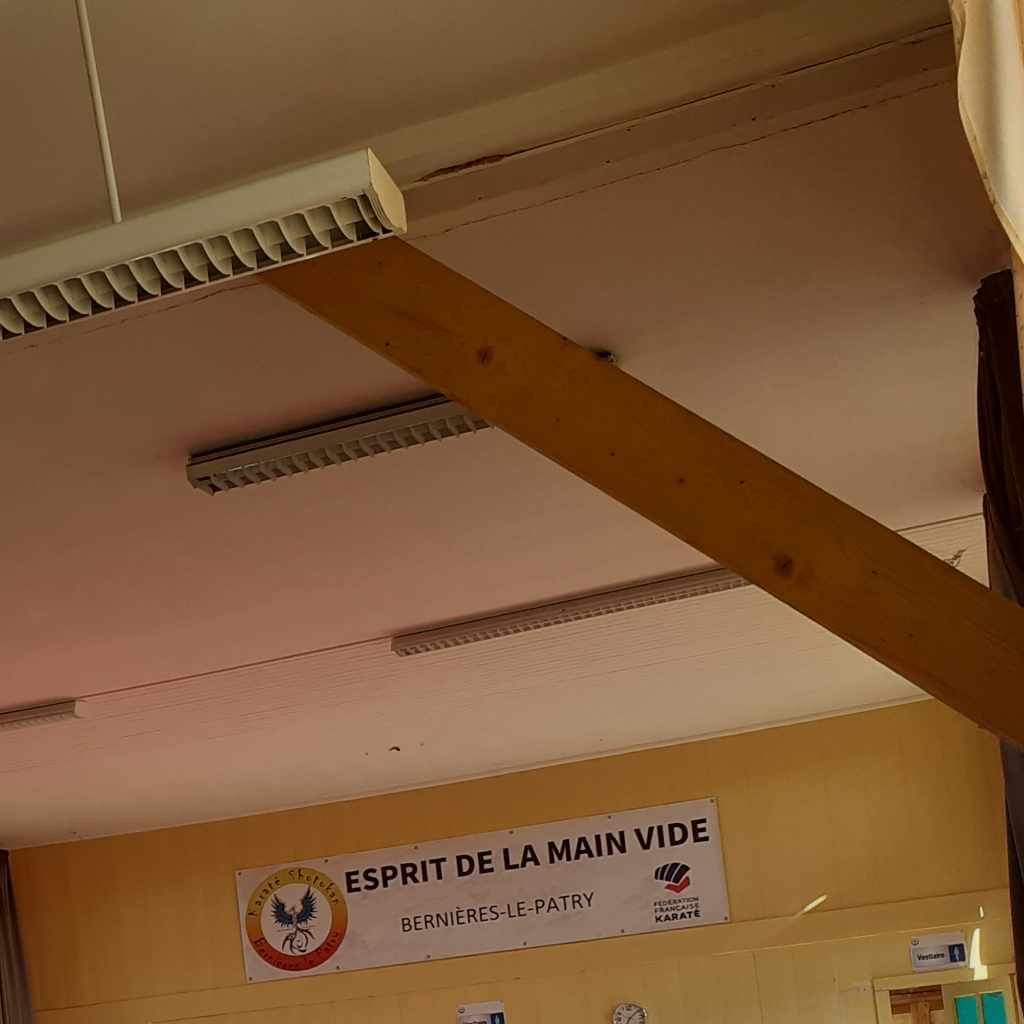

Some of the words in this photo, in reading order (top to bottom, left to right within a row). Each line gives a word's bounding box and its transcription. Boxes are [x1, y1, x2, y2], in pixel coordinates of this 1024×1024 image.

[345, 857, 448, 893] ESPRIT
[456, 850, 495, 877] DE
[503, 844, 541, 870] LA
[547, 830, 627, 865] MAIN
[634, 818, 710, 850] VIDE
[401, 892, 595, 932] BERNIÈRES-LE-PATRY
